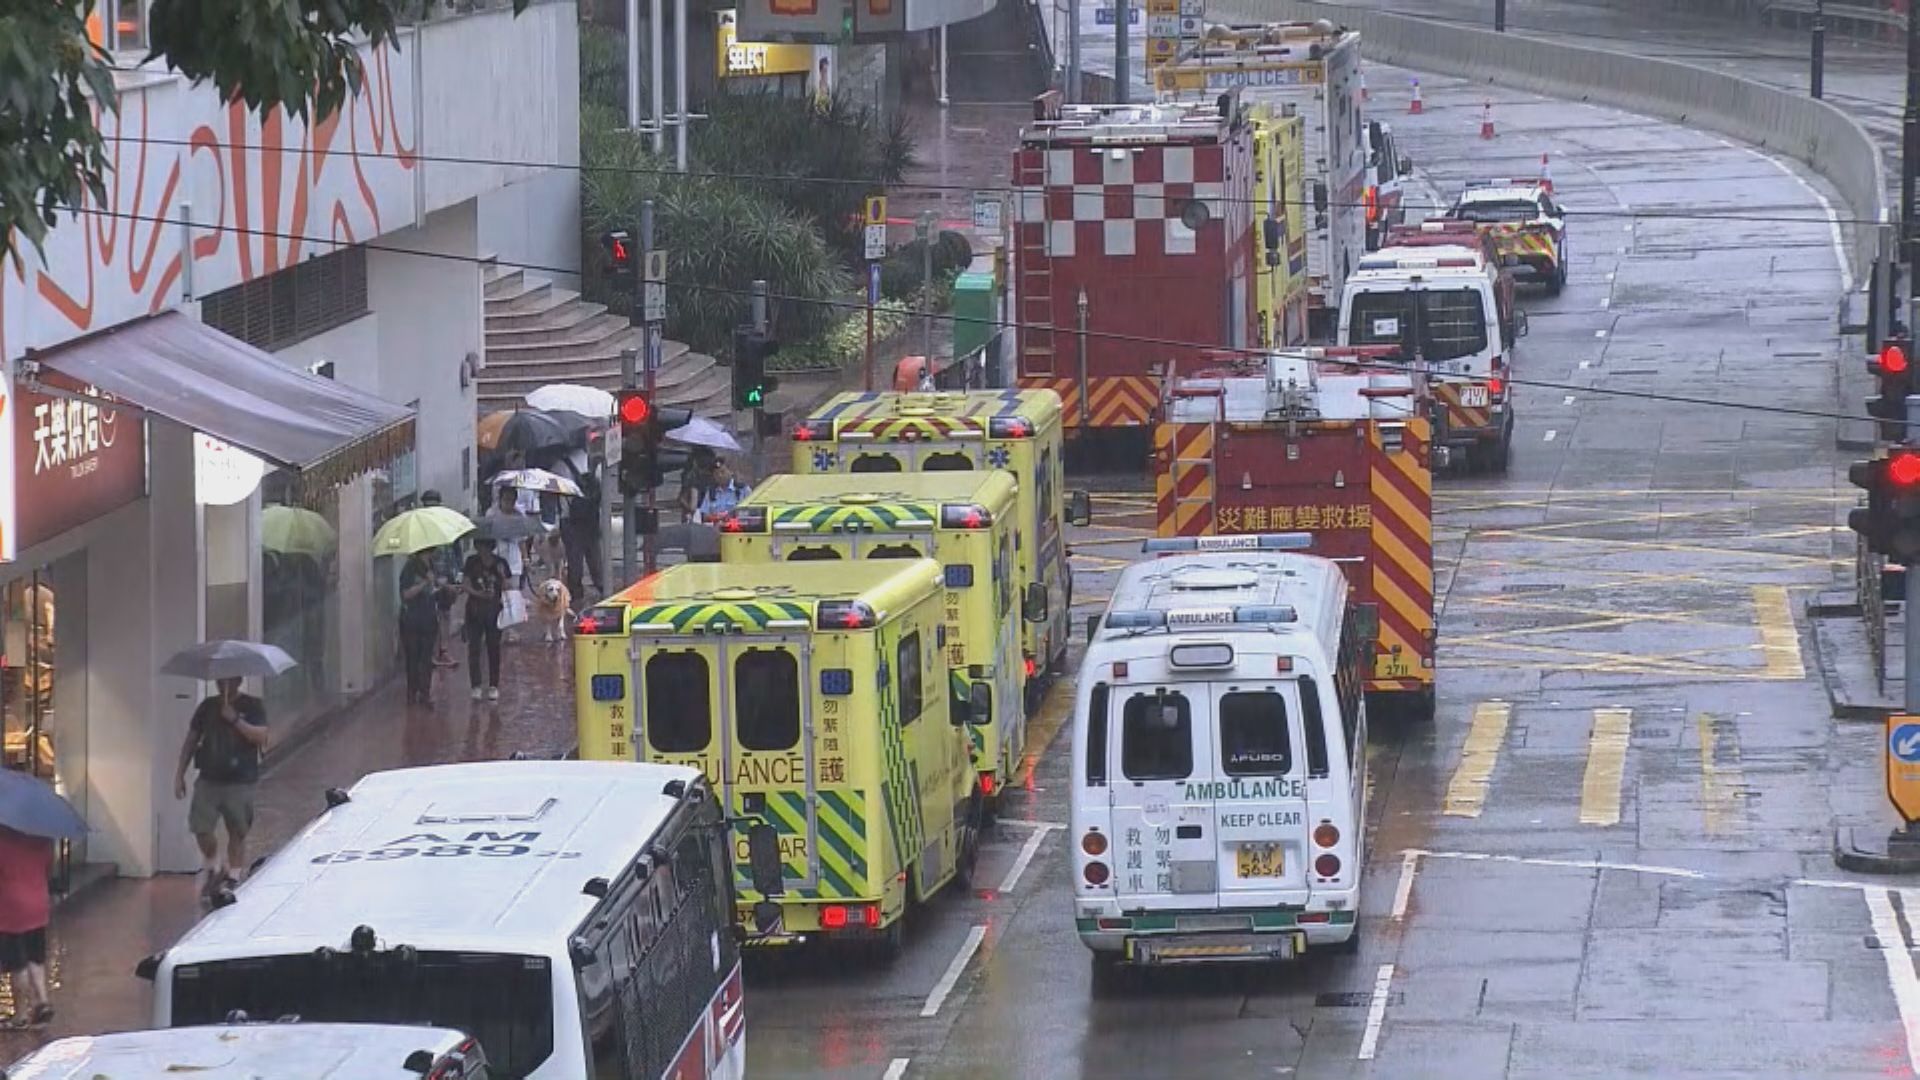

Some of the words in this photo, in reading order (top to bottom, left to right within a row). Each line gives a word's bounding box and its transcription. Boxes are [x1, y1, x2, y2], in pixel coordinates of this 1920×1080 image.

[728, 46, 767, 73] SELECT
[1225, 69, 1285, 86] POLICE
[1218, 504, 1372, 530] 災難應變救援
[1200, 537, 1257, 549] AMBULANCE
[1169, 612, 1231, 625] AMBULANCE
[1185, 780, 1301, 800] AMBULANCE
[1221, 814, 1254, 828] KEEP
[1258, 812, 1302, 826] CLEAR
[383, 831, 542, 847] AM
[1251, 851, 1272, 864] AM
